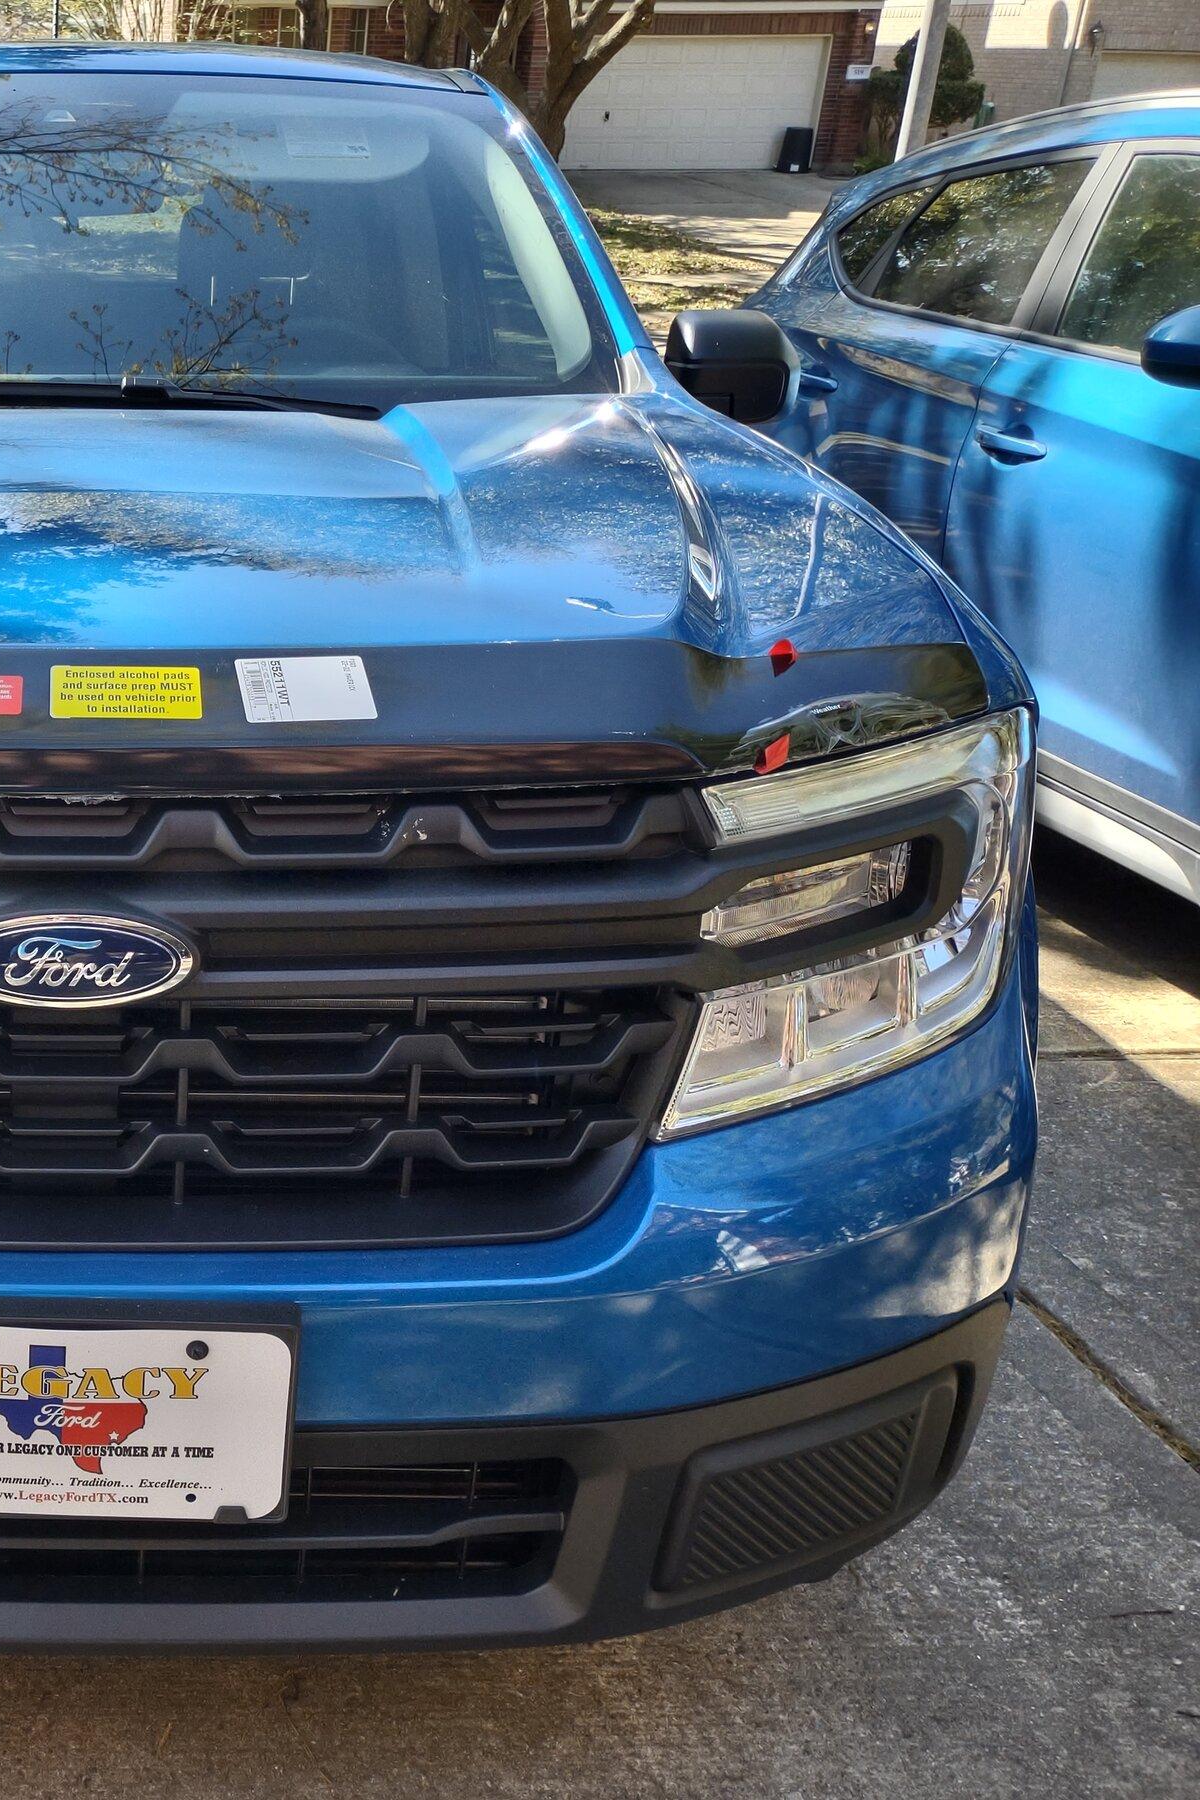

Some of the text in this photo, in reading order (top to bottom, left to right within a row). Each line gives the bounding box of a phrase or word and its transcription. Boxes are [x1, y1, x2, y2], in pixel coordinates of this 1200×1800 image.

[65, 669, 190, 681] Enclosed alcohol pads
[62, 681, 194, 692] and surface prep MUST
[270, 660, 291, 706] 55211WT
[60, 692, 196, 703] be used on vehicle prior
[87, 704, 170, 714] to installation.
[3, 936, 135, 987] Ford
[33, 1403, 102, 1429] Ford
[7, 1443, 54, 1456] LEGACY
[56, 1445, 81, 1457] ONE
[84, 1445, 149, 1458] CUSTOMER
[151, 1446, 167, 1458] AT
[170, 1447, 180, 1458] A
[184, 1447, 214, 1459] TIME
[69, 1477, 134, 1489] Tradition...
[138, 1478, 212, 1490] Excellence...
